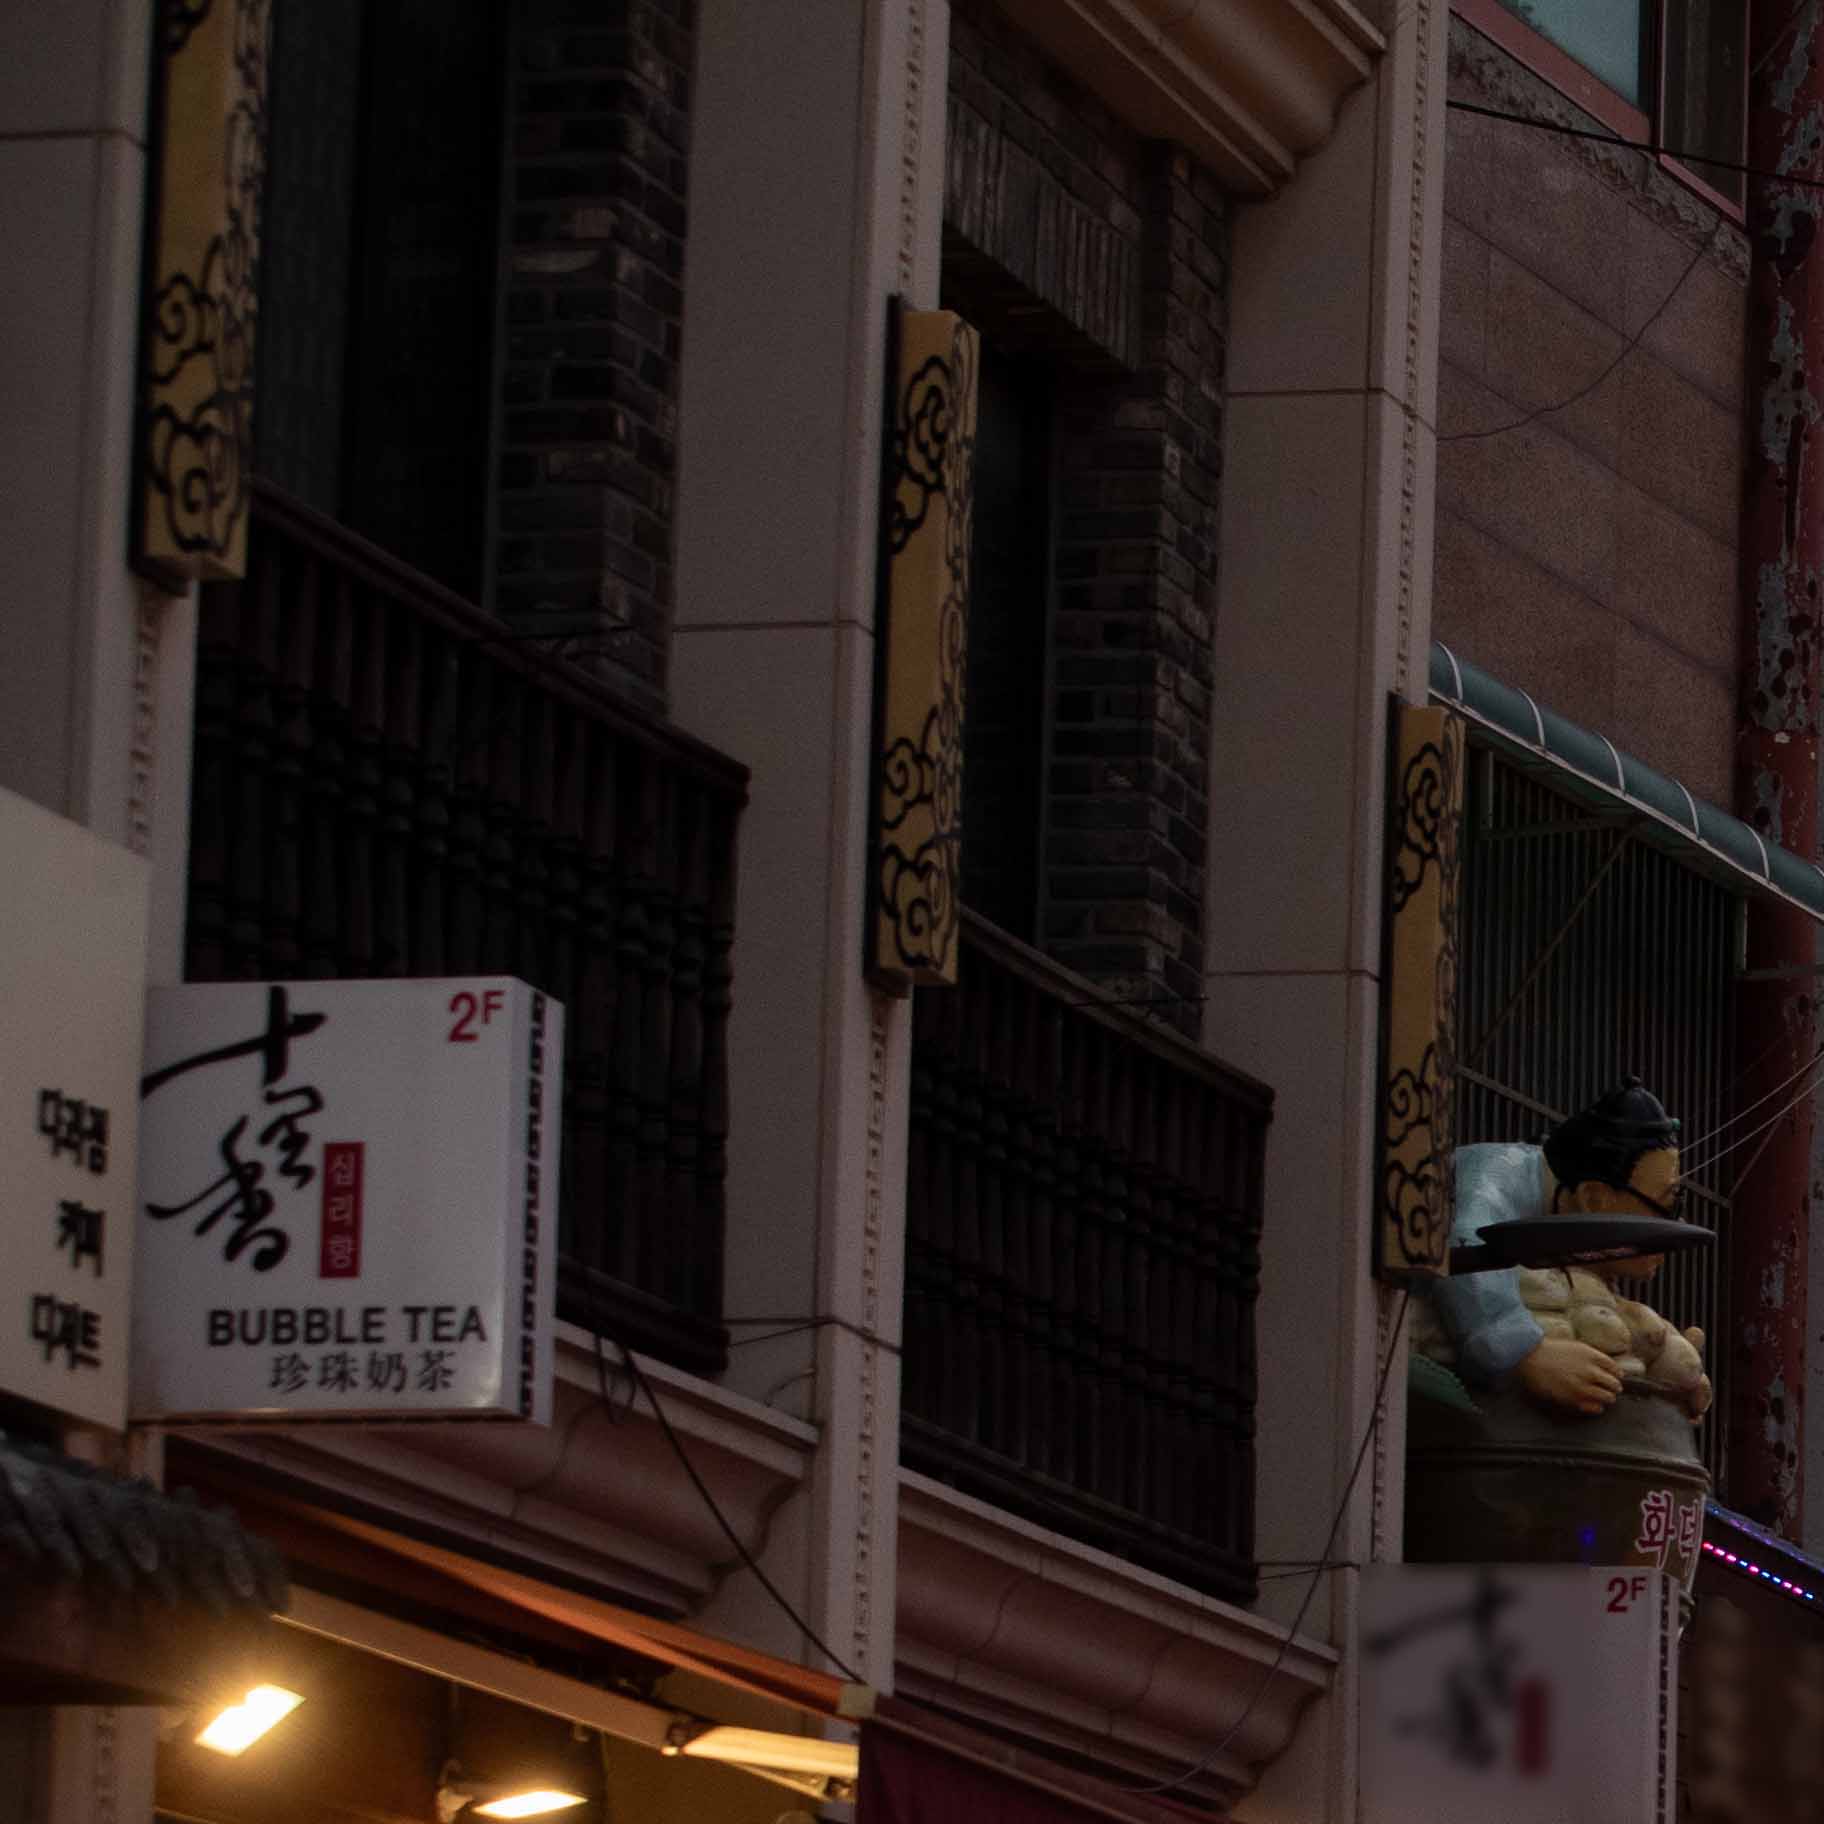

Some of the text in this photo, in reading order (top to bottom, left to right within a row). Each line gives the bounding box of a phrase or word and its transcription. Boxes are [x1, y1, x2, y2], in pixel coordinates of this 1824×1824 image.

[448, 990, 504, 1042] 2F
[208, 1306, 487, 1346] BUBBLE TEA
[269, 1350, 456, 1394] 珍珠奶茶
[1607, 1577, 1647, 1612] 2F
